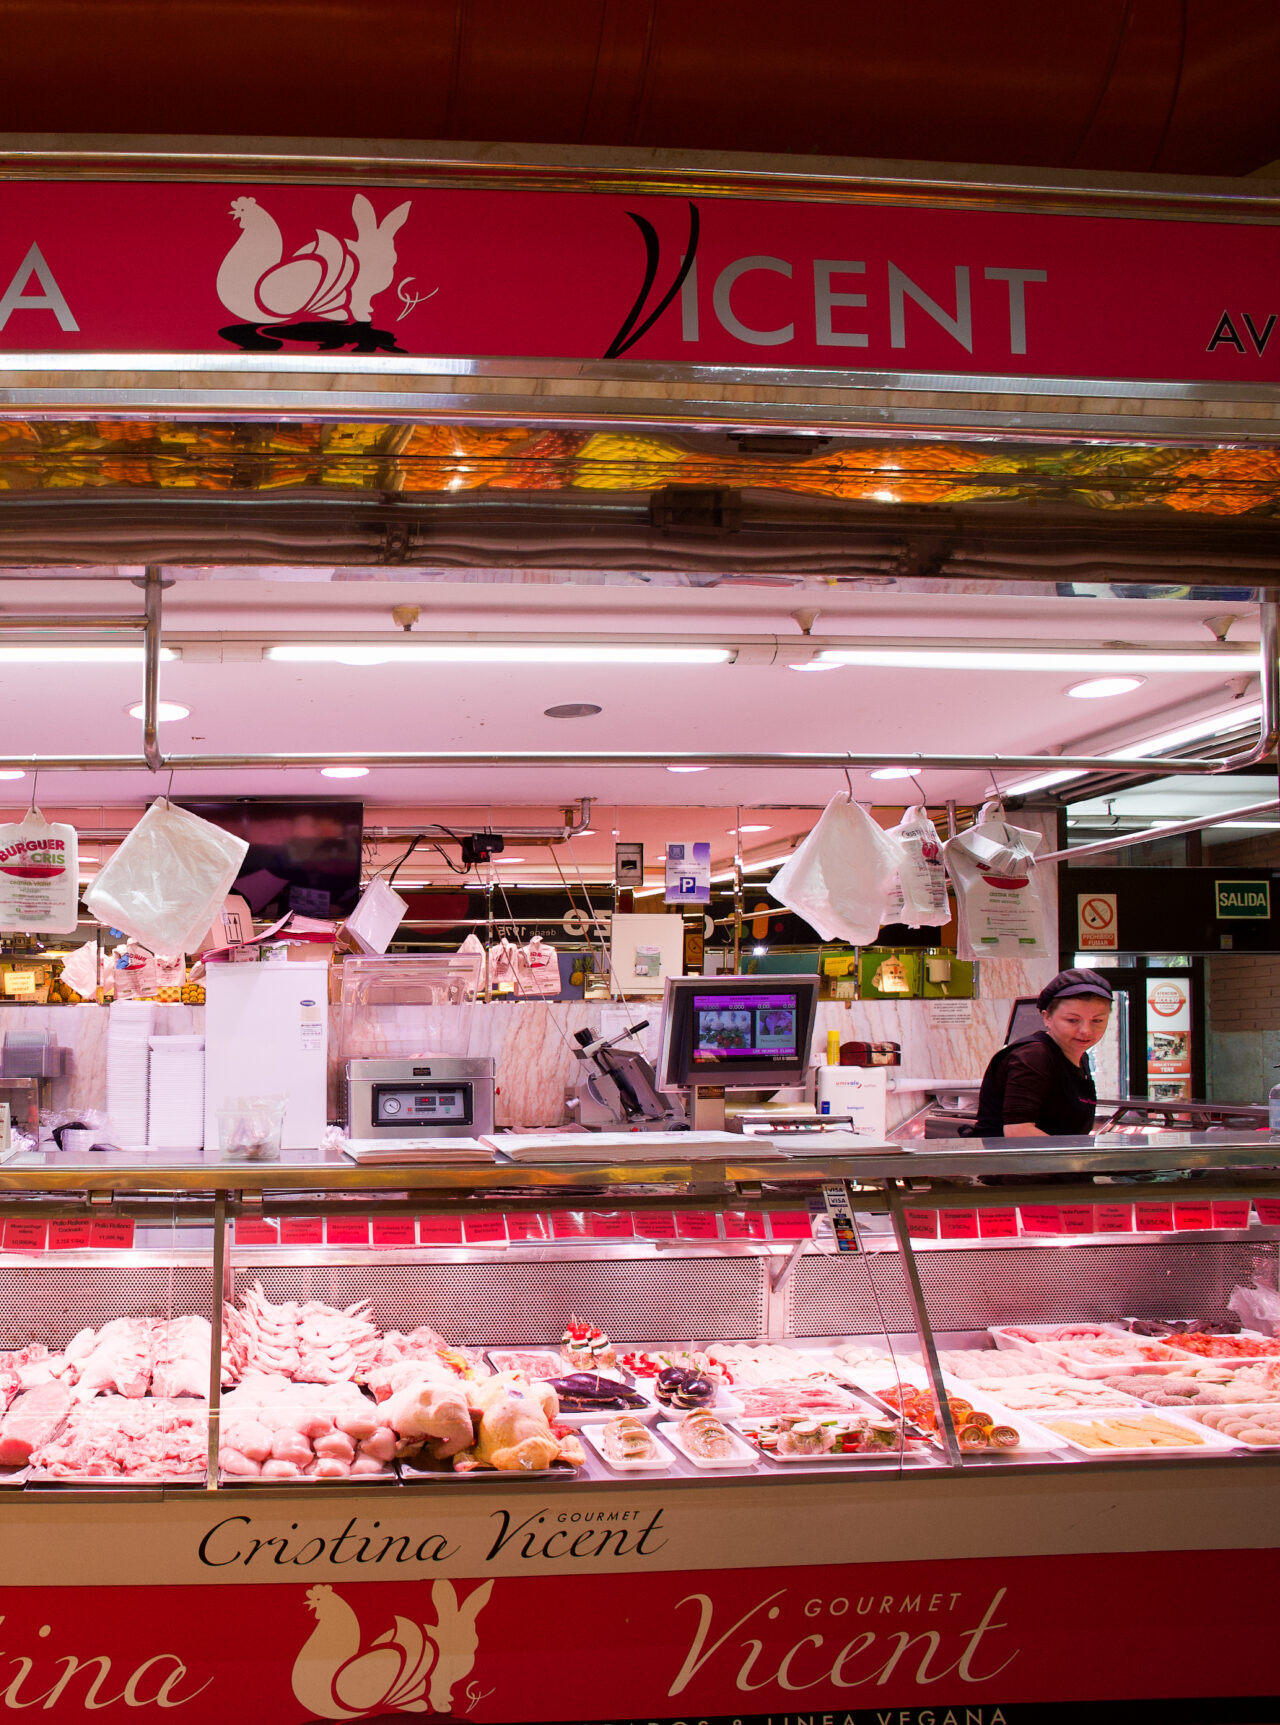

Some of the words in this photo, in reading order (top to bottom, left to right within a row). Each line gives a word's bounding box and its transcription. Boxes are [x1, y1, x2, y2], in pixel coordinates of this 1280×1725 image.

[603, 202, 1048, 359] VICENT
[31, 853, 65, 864] CRIS
[682, 878, 694, 893] P
[1219, 892, 1266, 907] SALIDA
[557, 1510, 641, 1523] GOURMET
[197, 1515, 461, 1566] Cristina
[486, 1507, 669, 1561] Vicent
[804, 1591, 962, 1618] GOURMET
[667, 1586, 1020, 1697] Vicent
[876, 1707, 1006, 1725] VEGANA
